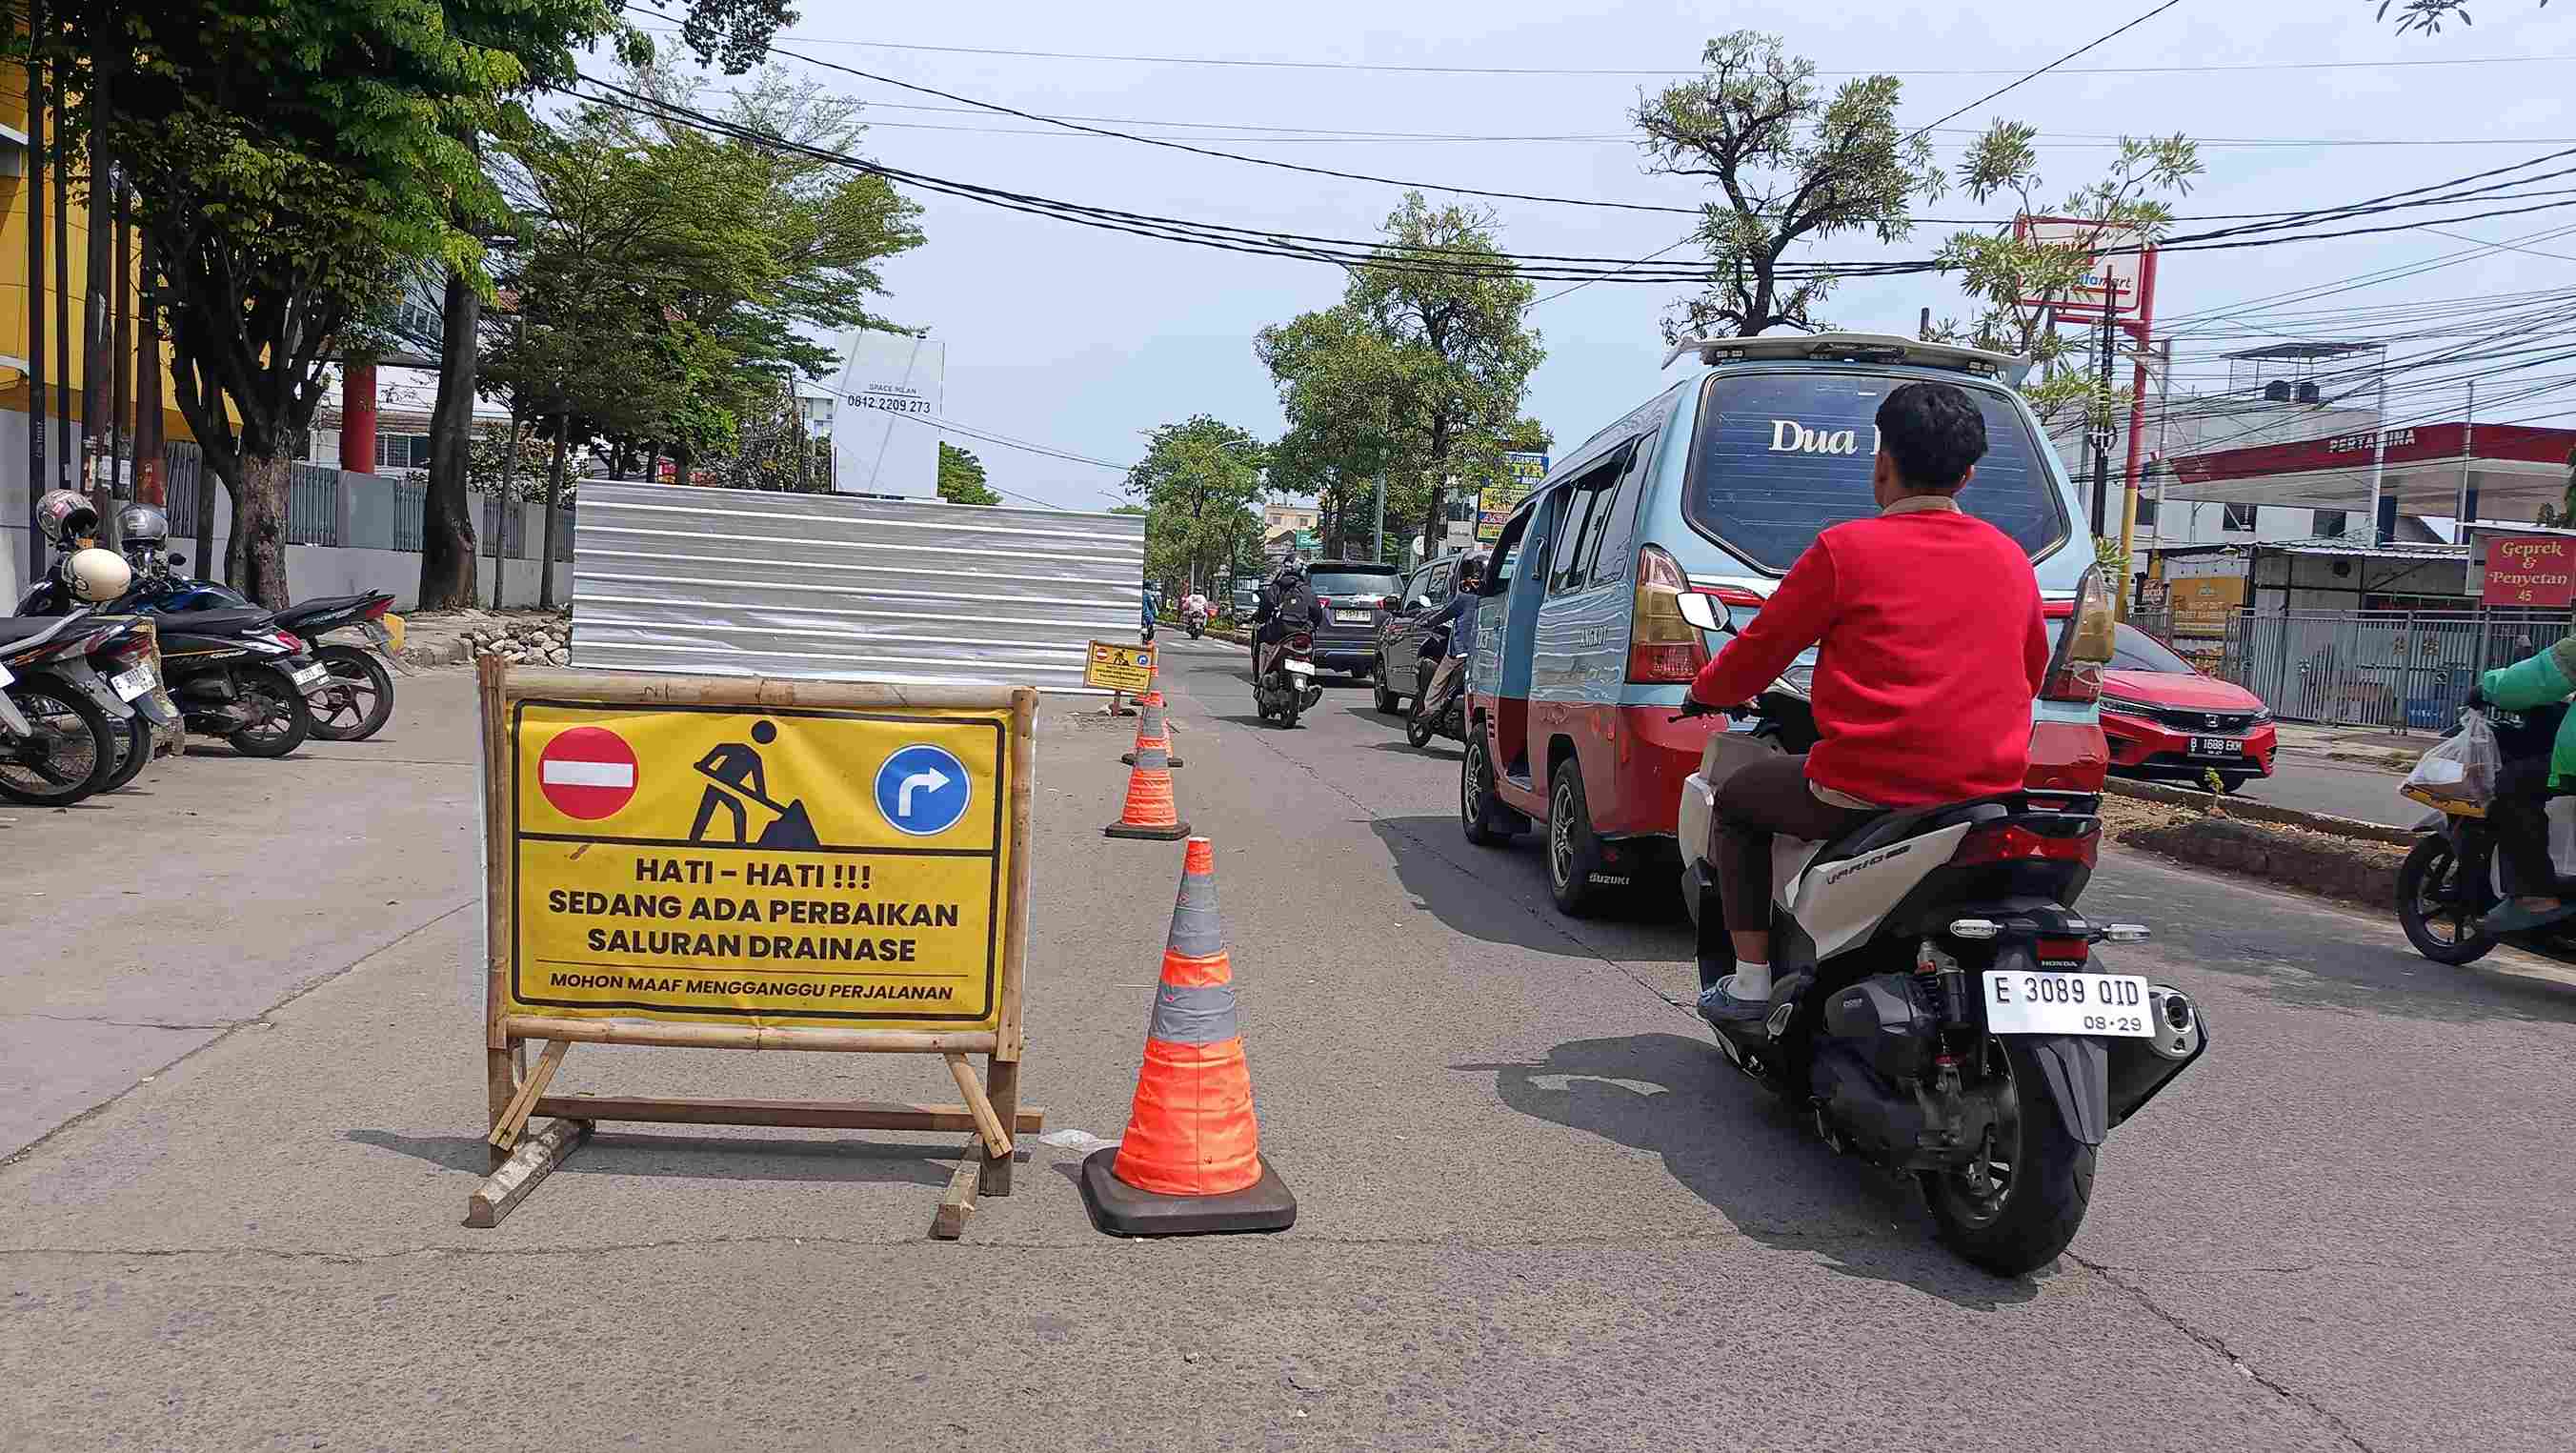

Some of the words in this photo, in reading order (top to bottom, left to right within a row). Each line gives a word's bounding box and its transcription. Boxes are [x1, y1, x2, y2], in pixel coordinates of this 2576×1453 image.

[1768, 419, 1859, 454] Dua
[2502, 540, 2565, 558] Geprek
[2522, 556, 2537, 570] &
[2489, 571, 2567, 587] Penyetan
[2518, 589, 2533, 602] 45
[635, 858, 714, 885] HATI
[746, 861, 825, 888] HATI
[834, 864, 871, 890] !!!
[1589, 872, 1630, 885] SUZUKI
[548, 889, 682, 919] SEDANG
[689, 898, 762, 922] ADA
[769, 898, 959, 927] PERBAIKAN
[587, 928, 740, 959] SALURAN
[748, 934, 916, 961] DRAINASE
[550, 972, 625, 990] MOHON
[627, 977, 682, 993] MAAF
[685, 979, 826, 999] MENGGANGGU
[828, 983, 954, 1000] PERJALANAN
[1995, 977, 2010, 1003] E
[2024, 978, 2084, 1003] 3089
[2099, 980, 2140, 1005] QID
